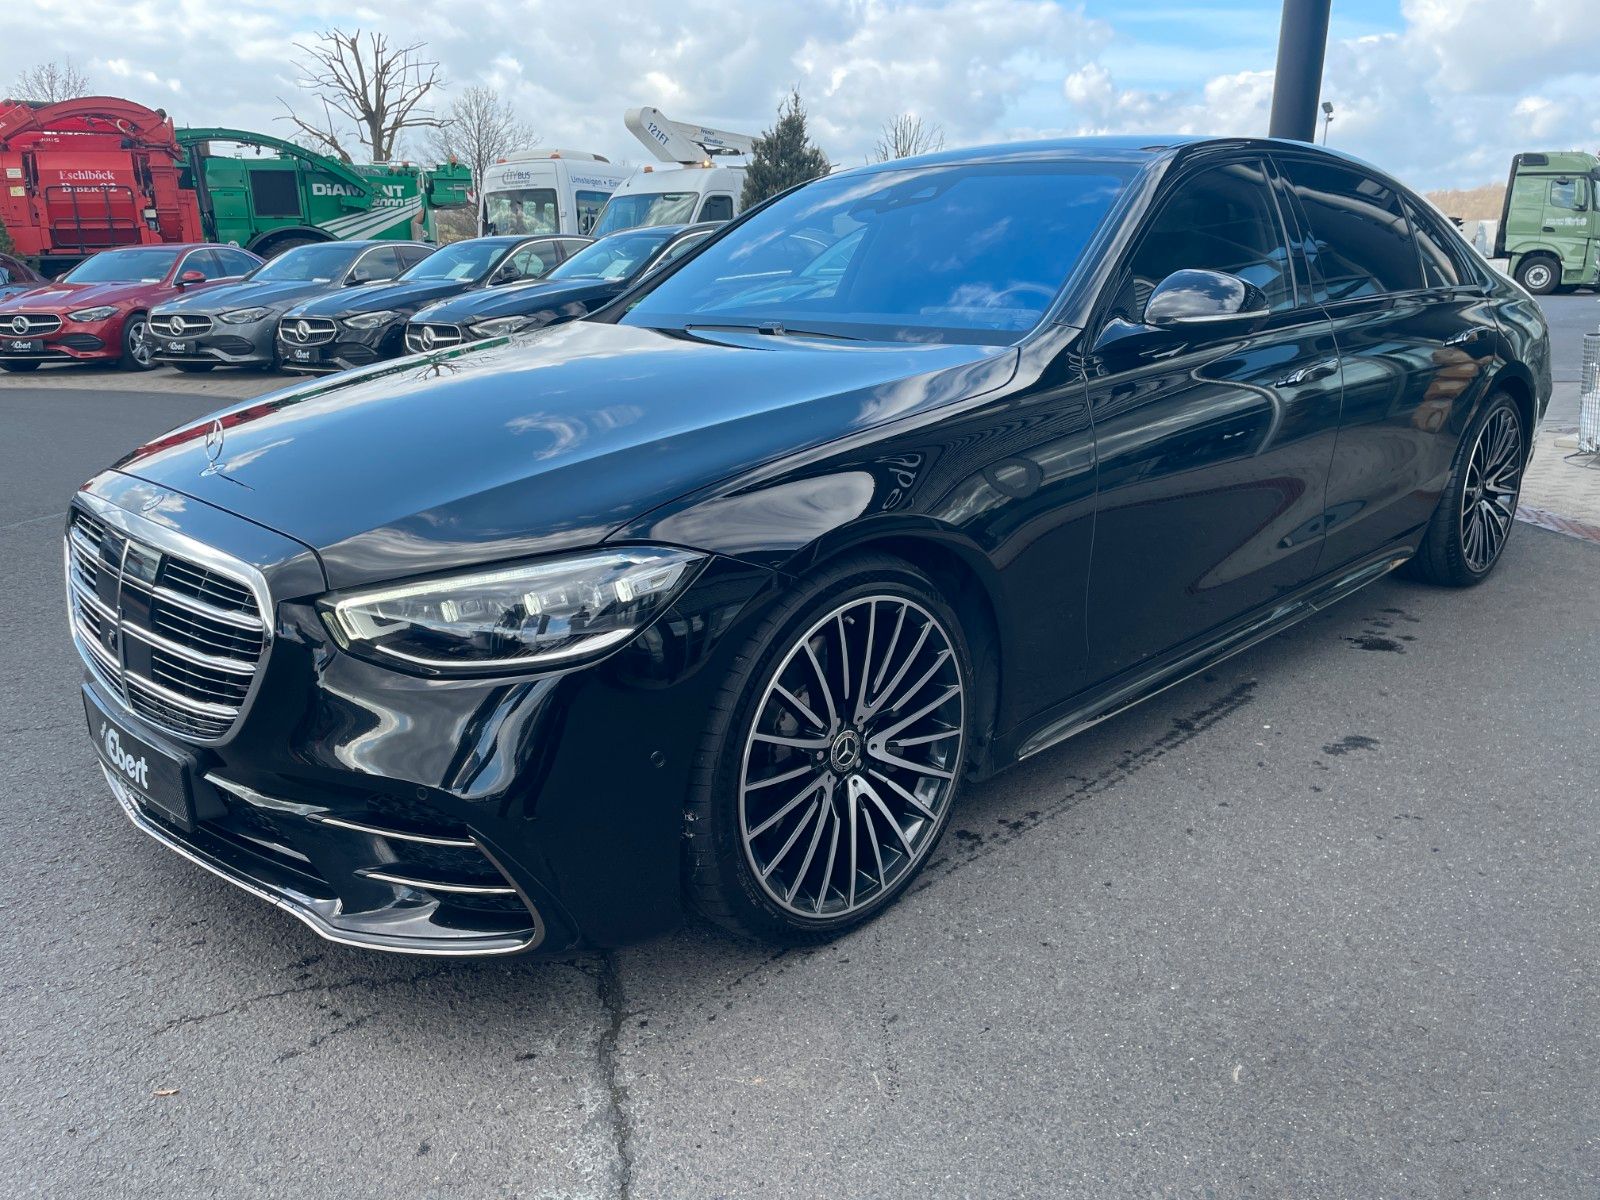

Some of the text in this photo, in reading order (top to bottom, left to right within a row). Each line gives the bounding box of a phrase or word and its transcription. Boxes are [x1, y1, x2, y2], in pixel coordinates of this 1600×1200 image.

[647, 122, 669, 145] 121FT
[59, 169, 116, 181] Eschlböck
[311, 183, 405, 198] DiAMNT
[105, 728, 148, 790] Ebert
